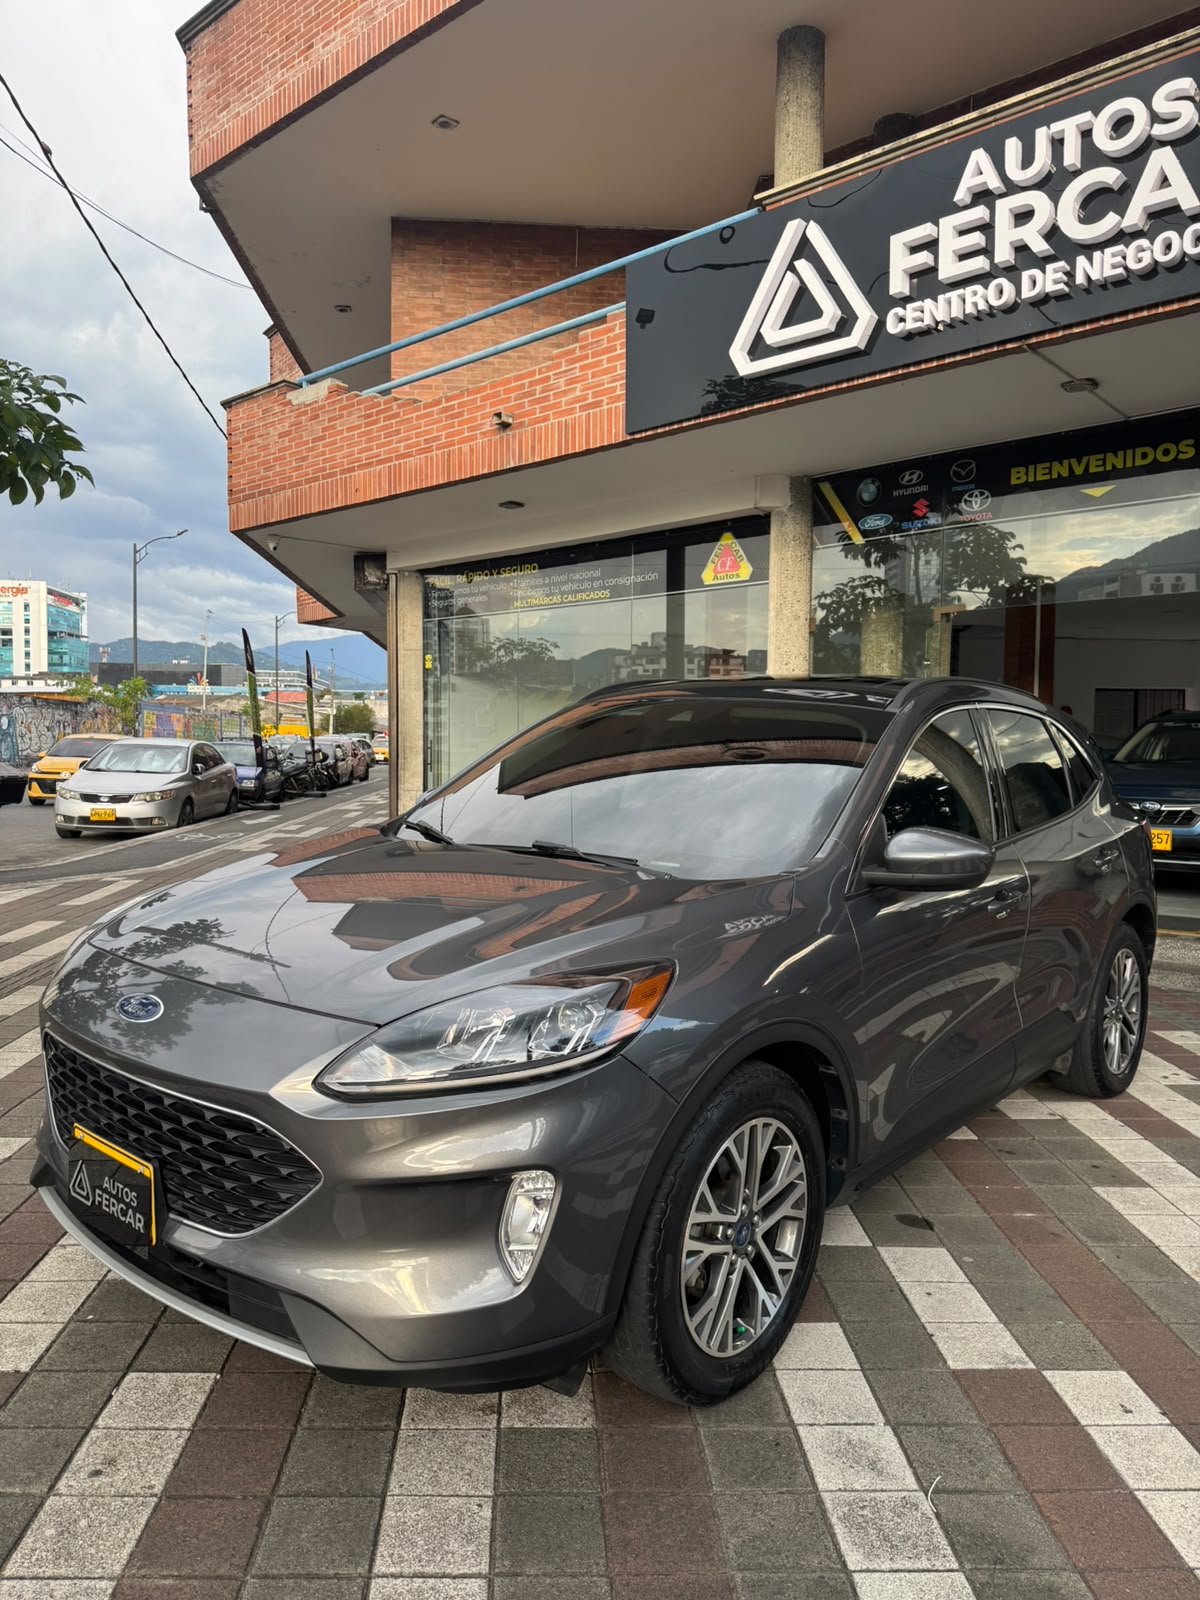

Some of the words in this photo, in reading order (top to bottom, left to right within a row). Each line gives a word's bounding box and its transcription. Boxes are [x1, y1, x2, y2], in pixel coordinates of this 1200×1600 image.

[953, 77, 1200, 207] AUTOS
[889, 145, 1200, 299] FERCA
[886, 277, 1016, 338] CENTRO
[1021, 260, 1071, 302] DE
[1010, 439, 1196, 485] BIENVENIDOS
[893, 485, 928, 497] HYUNDAI
[960, 512, 992, 522] TOYOTA
[492, 569, 498, 579] Y
[500, 563, 539, 578] SEGURO
[569, 568, 601, 581] nacional
[712, 572, 740, 582] Autos
[593, 579, 604, 588] en
[605, 572, 659, 587] consignación
[562, 589, 610, 602] CALIFICADOS
[103, 1176, 137, 1207] AUTOS
[95, 1188, 144, 1233] FERCAR
